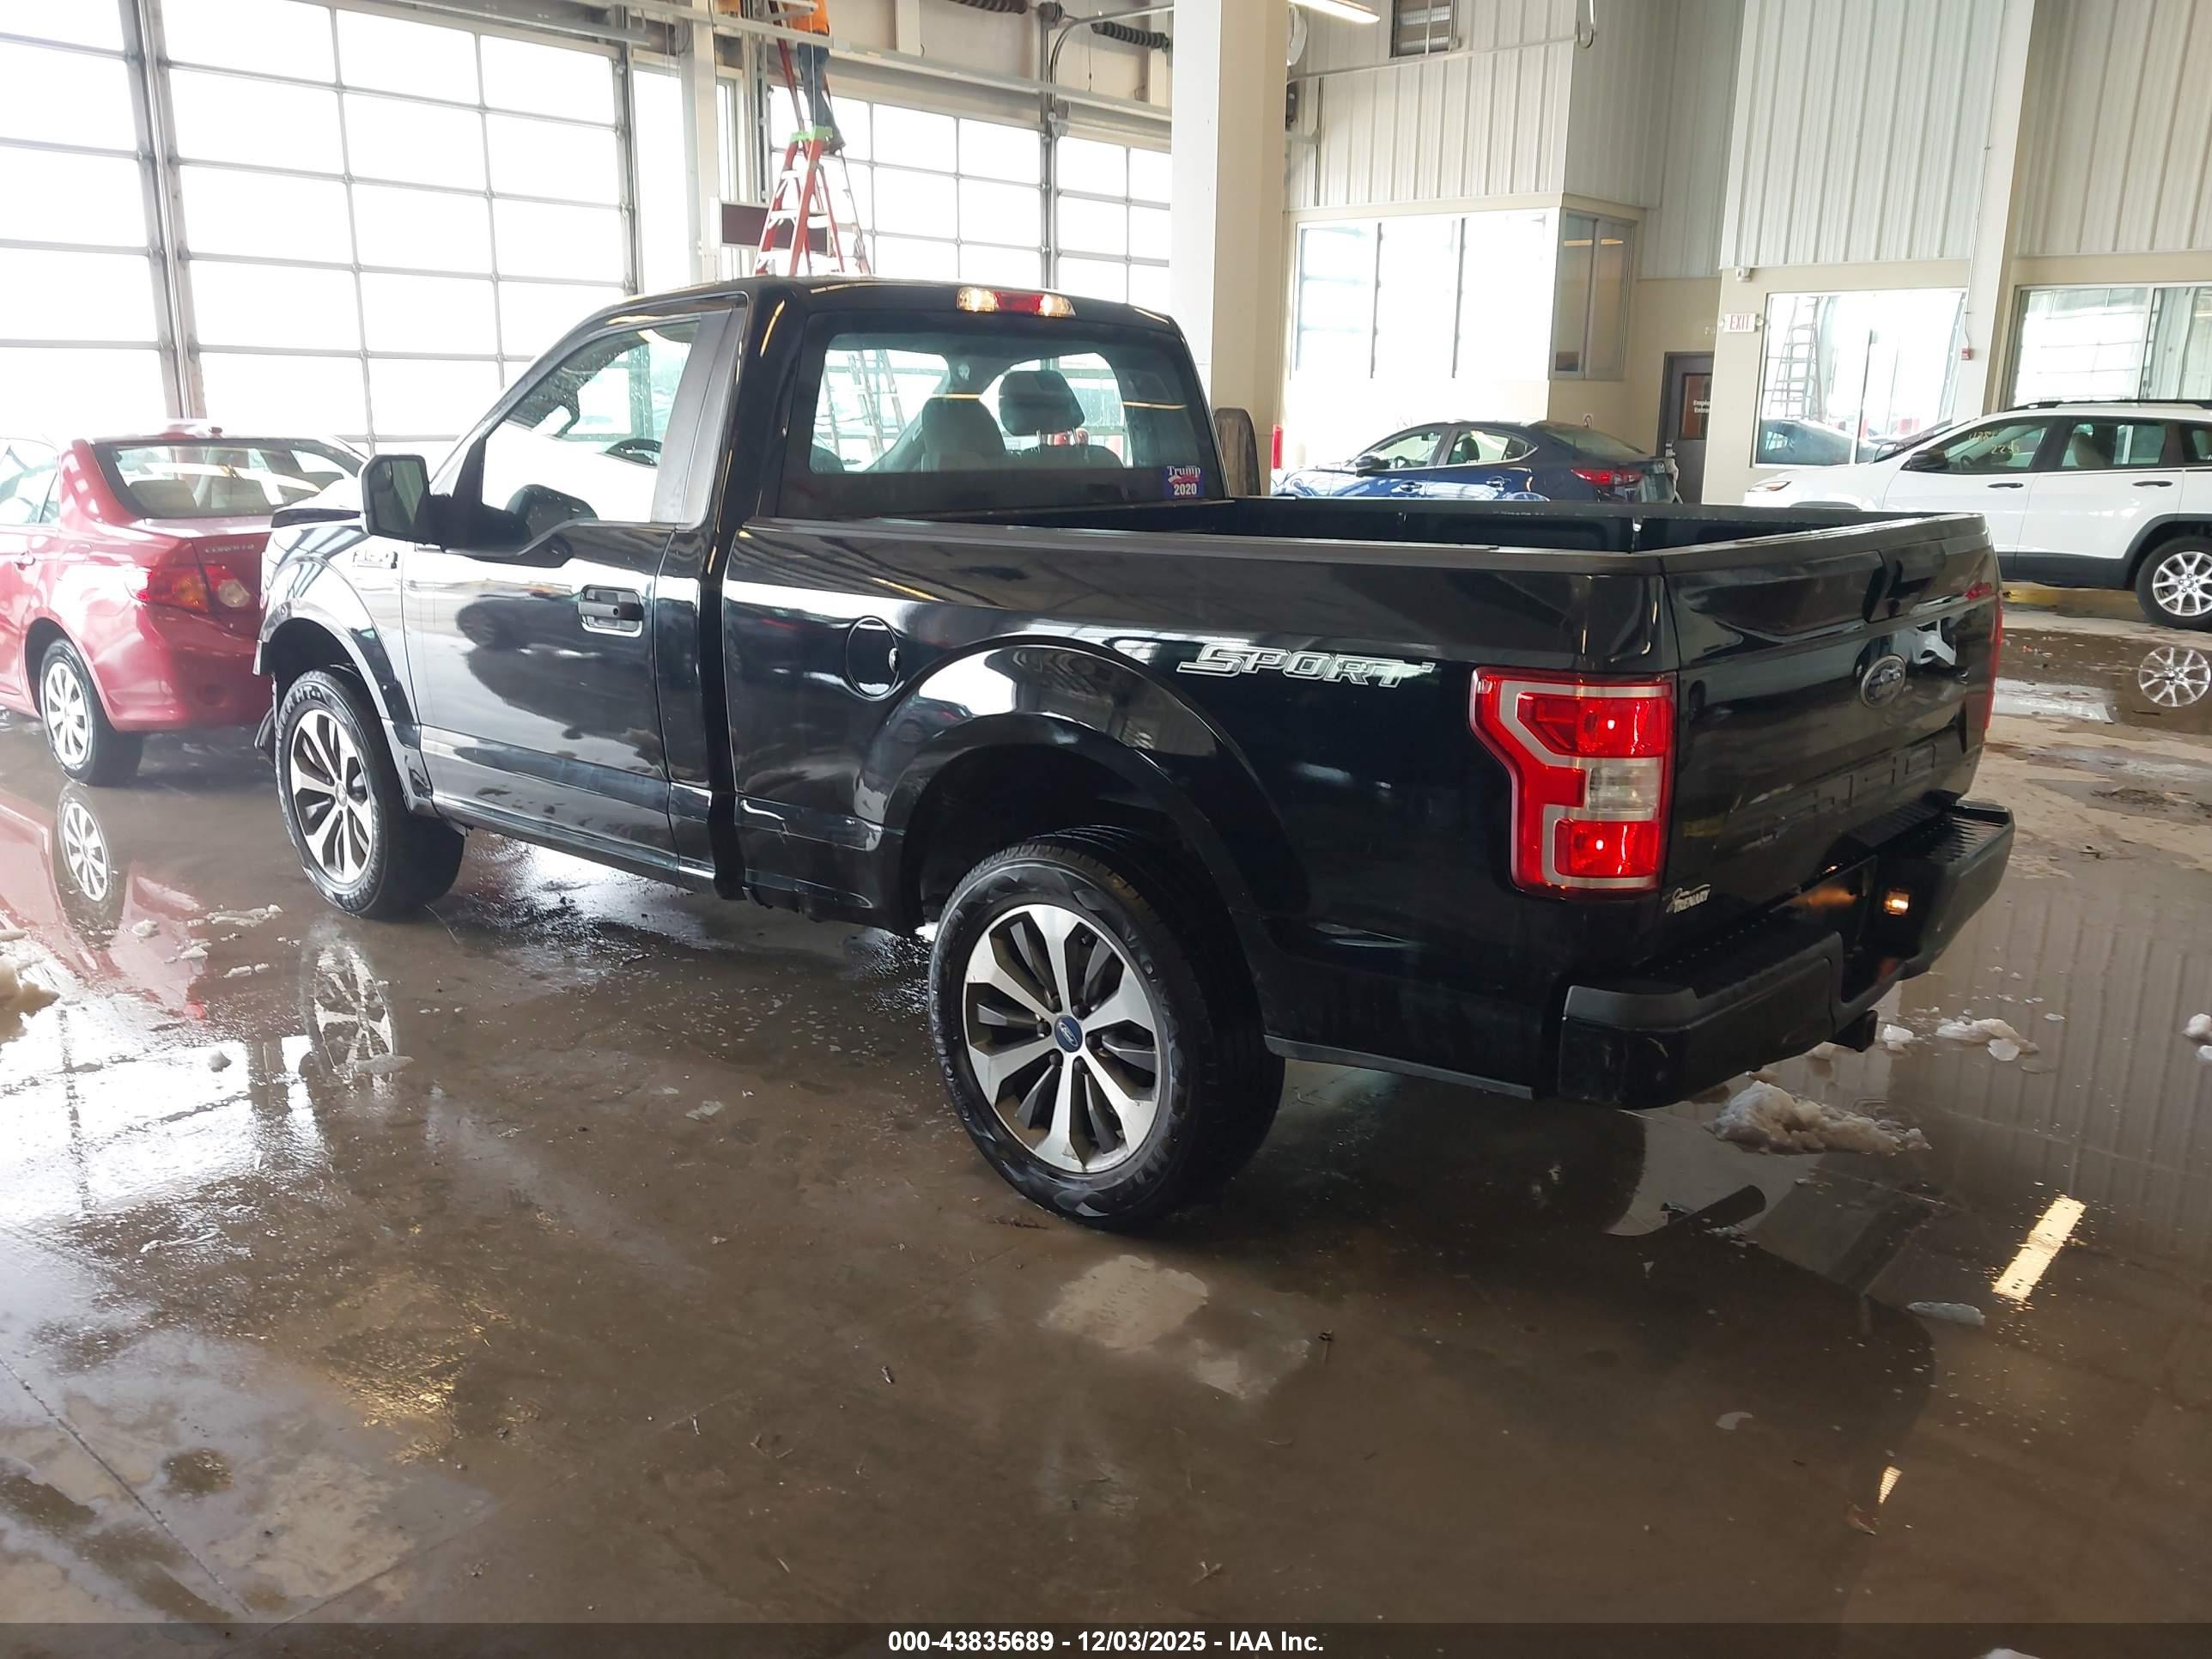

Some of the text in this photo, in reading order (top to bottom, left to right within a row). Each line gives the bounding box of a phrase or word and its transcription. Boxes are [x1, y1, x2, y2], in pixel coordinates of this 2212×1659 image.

[1730, 315, 1751, 330] EXIT
[1167, 465, 1200, 478] Trump
[1174, 483, 1197, 495] 2020
[1176, 643, 1436, 689] SPORT
